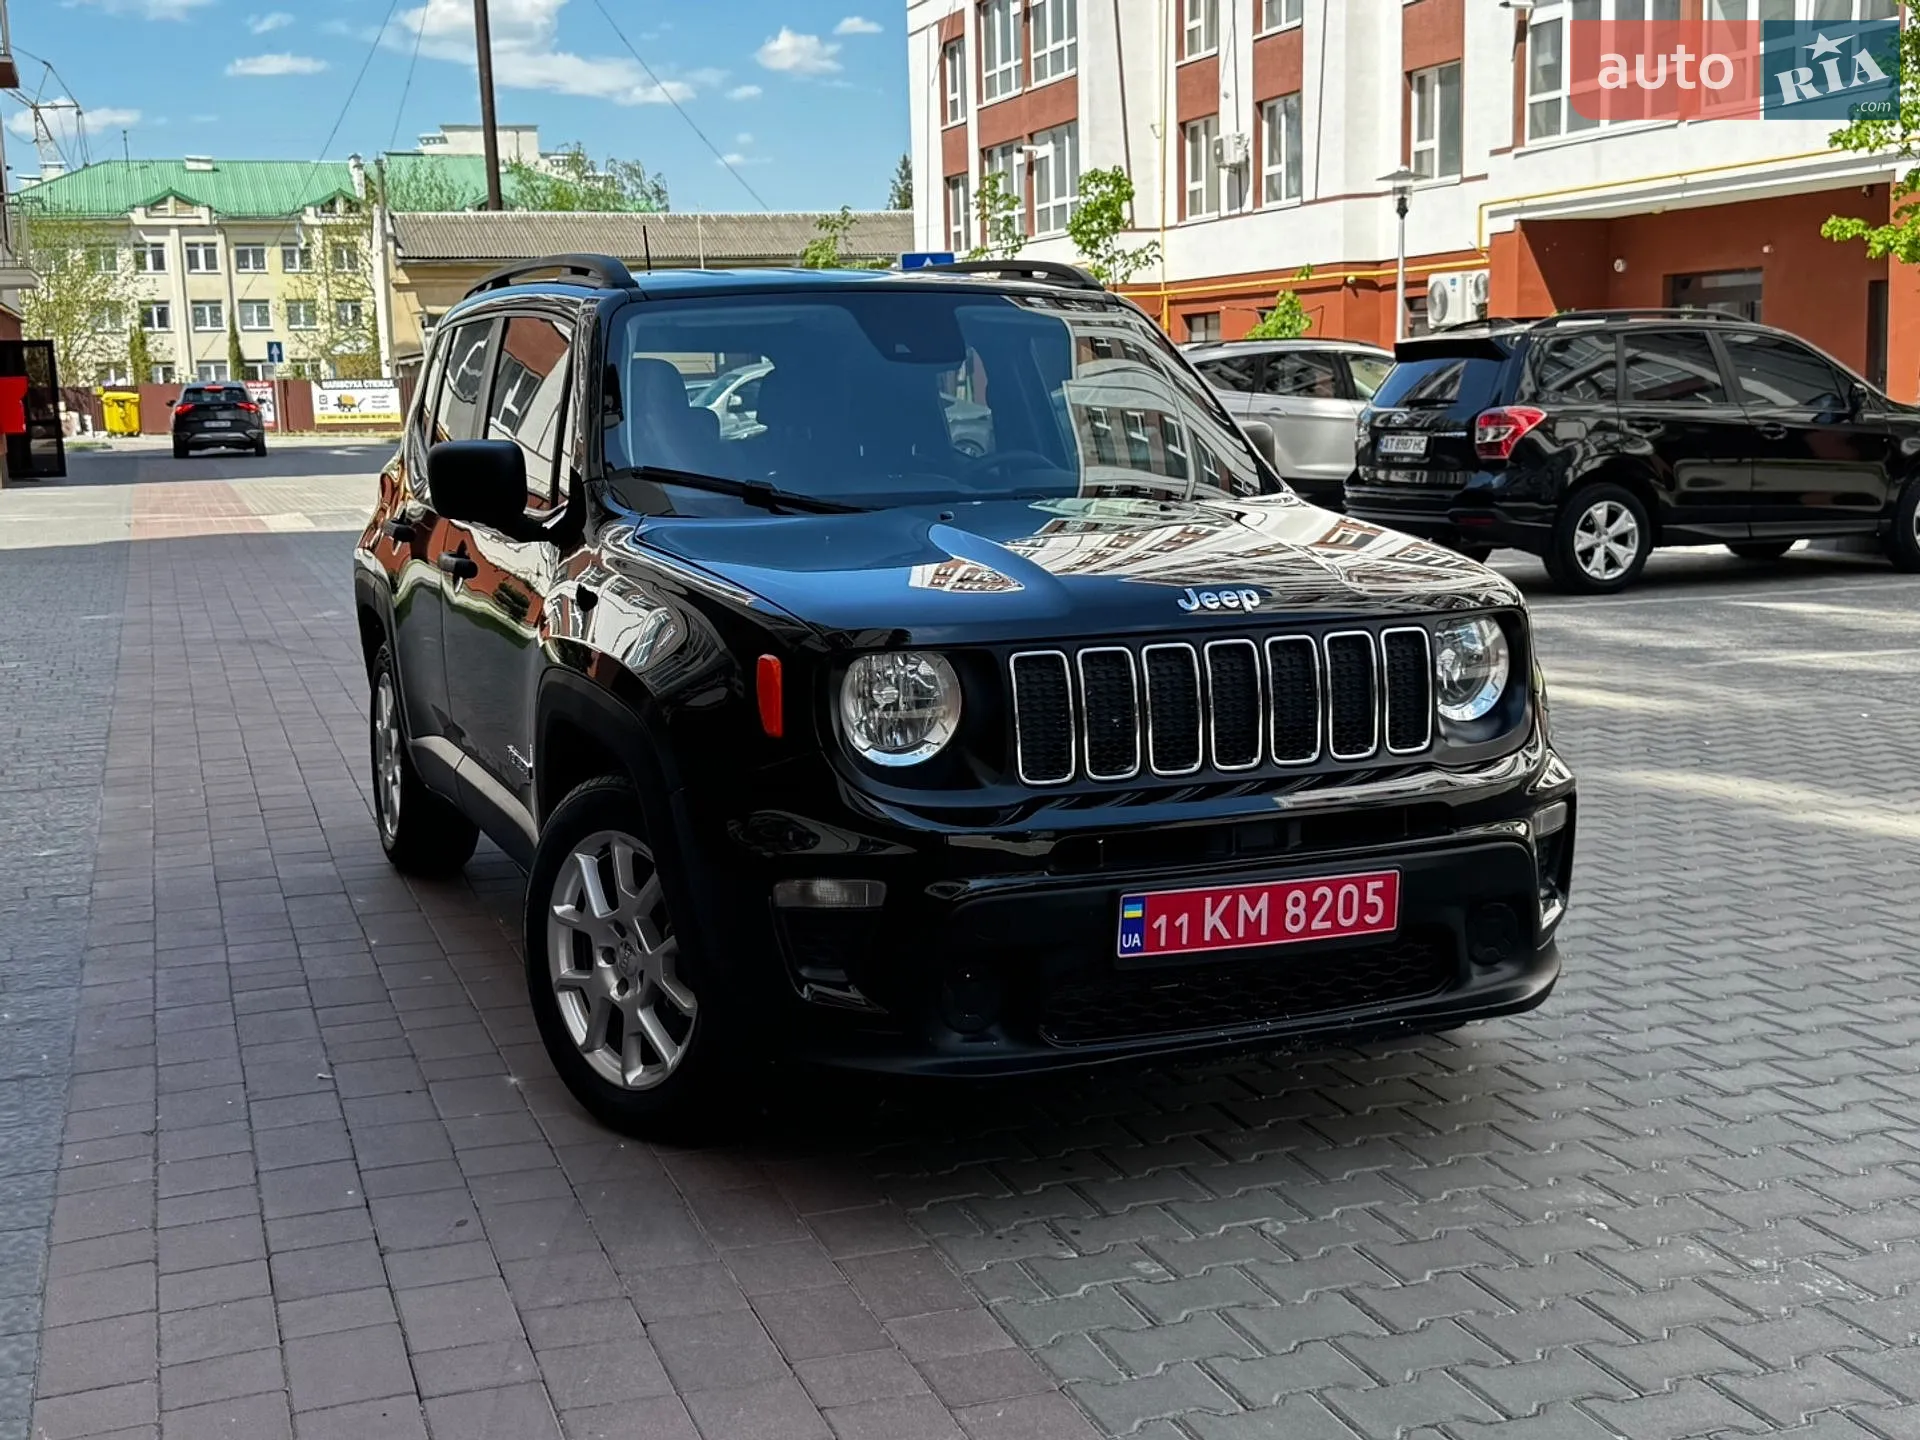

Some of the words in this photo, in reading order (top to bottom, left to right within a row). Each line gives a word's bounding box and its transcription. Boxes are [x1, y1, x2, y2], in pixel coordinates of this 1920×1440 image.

[1177, 588, 1260, 613] Jeep
[1152, 913, 1189, 947] 11
[1204, 892, 1269, 941] KM
[1285, 881, 1384, 933] 8205
[1122, 933, 1142, 948] UA
